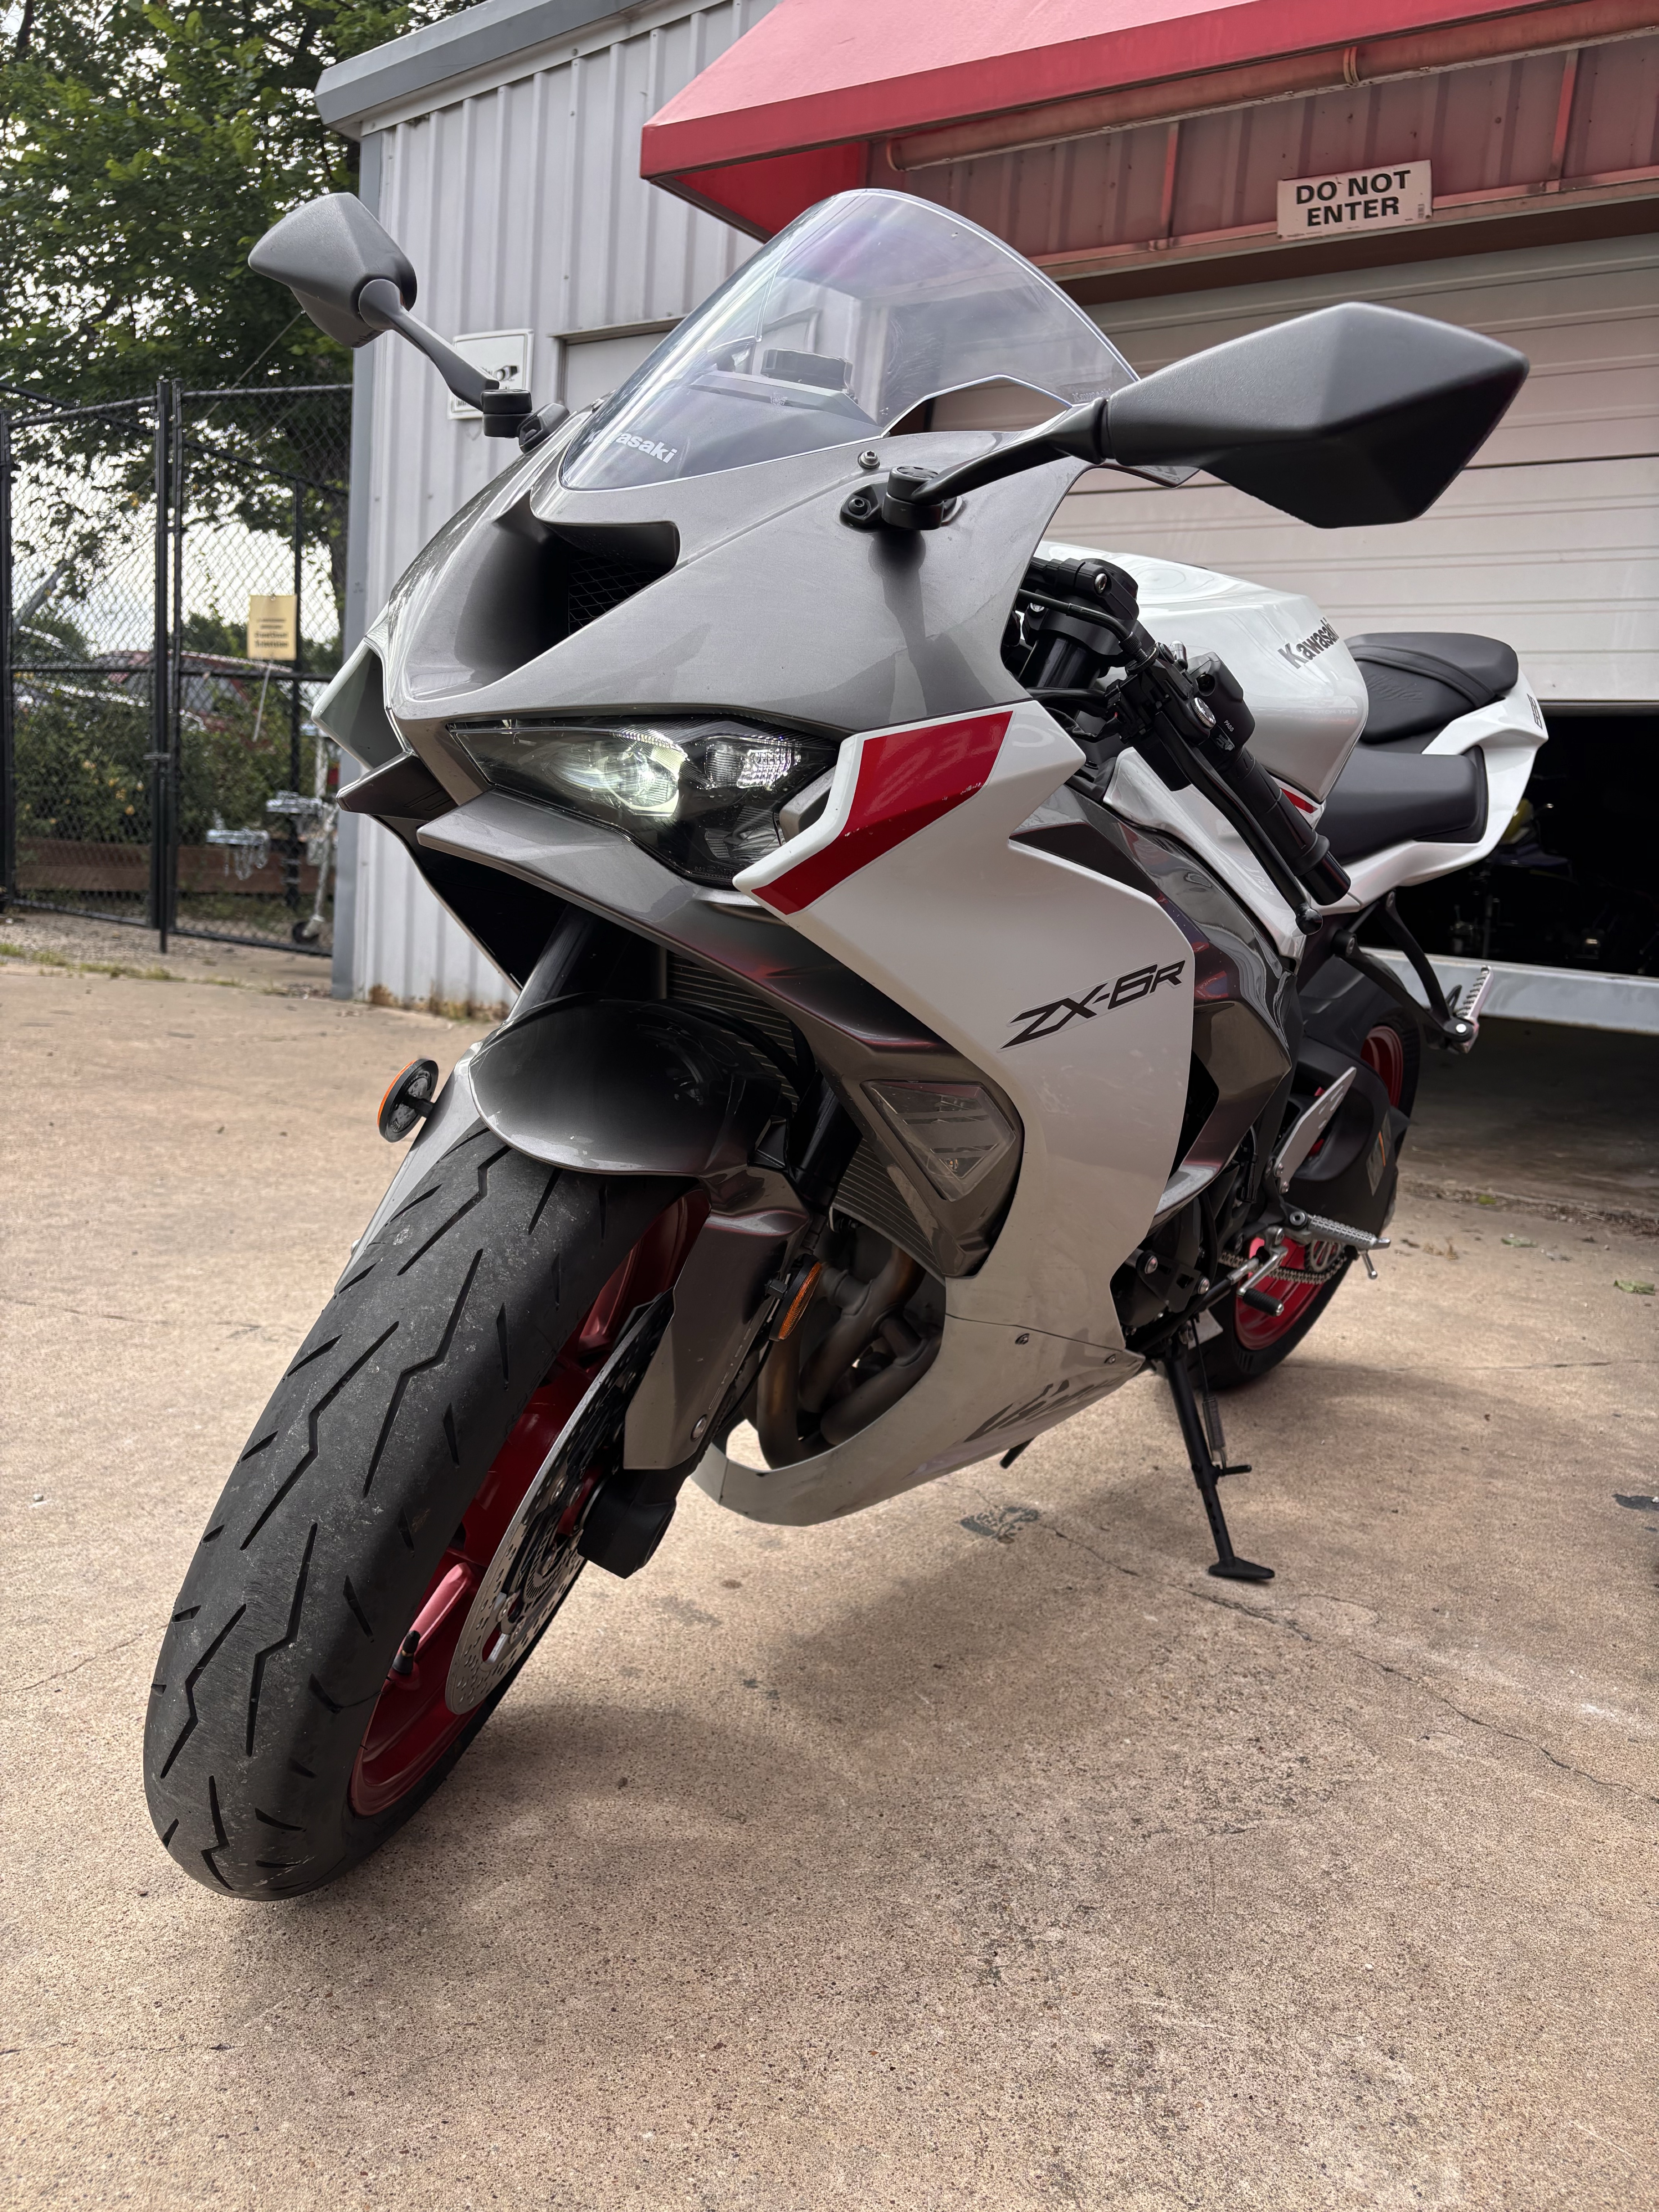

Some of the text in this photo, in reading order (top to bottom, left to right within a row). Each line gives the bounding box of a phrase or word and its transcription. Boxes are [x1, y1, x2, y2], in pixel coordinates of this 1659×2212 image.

[1296, 170, 1411, 204] DO NOT
[1308, 196, 1399, 226] ENTER
[583, 430, 678, 463] asaki
[1277, 617, 1340, 669] Kawasaki
[1224, 720, 1234, 732] PASS
[999, 960, 1186, 1049] ZX-6R
